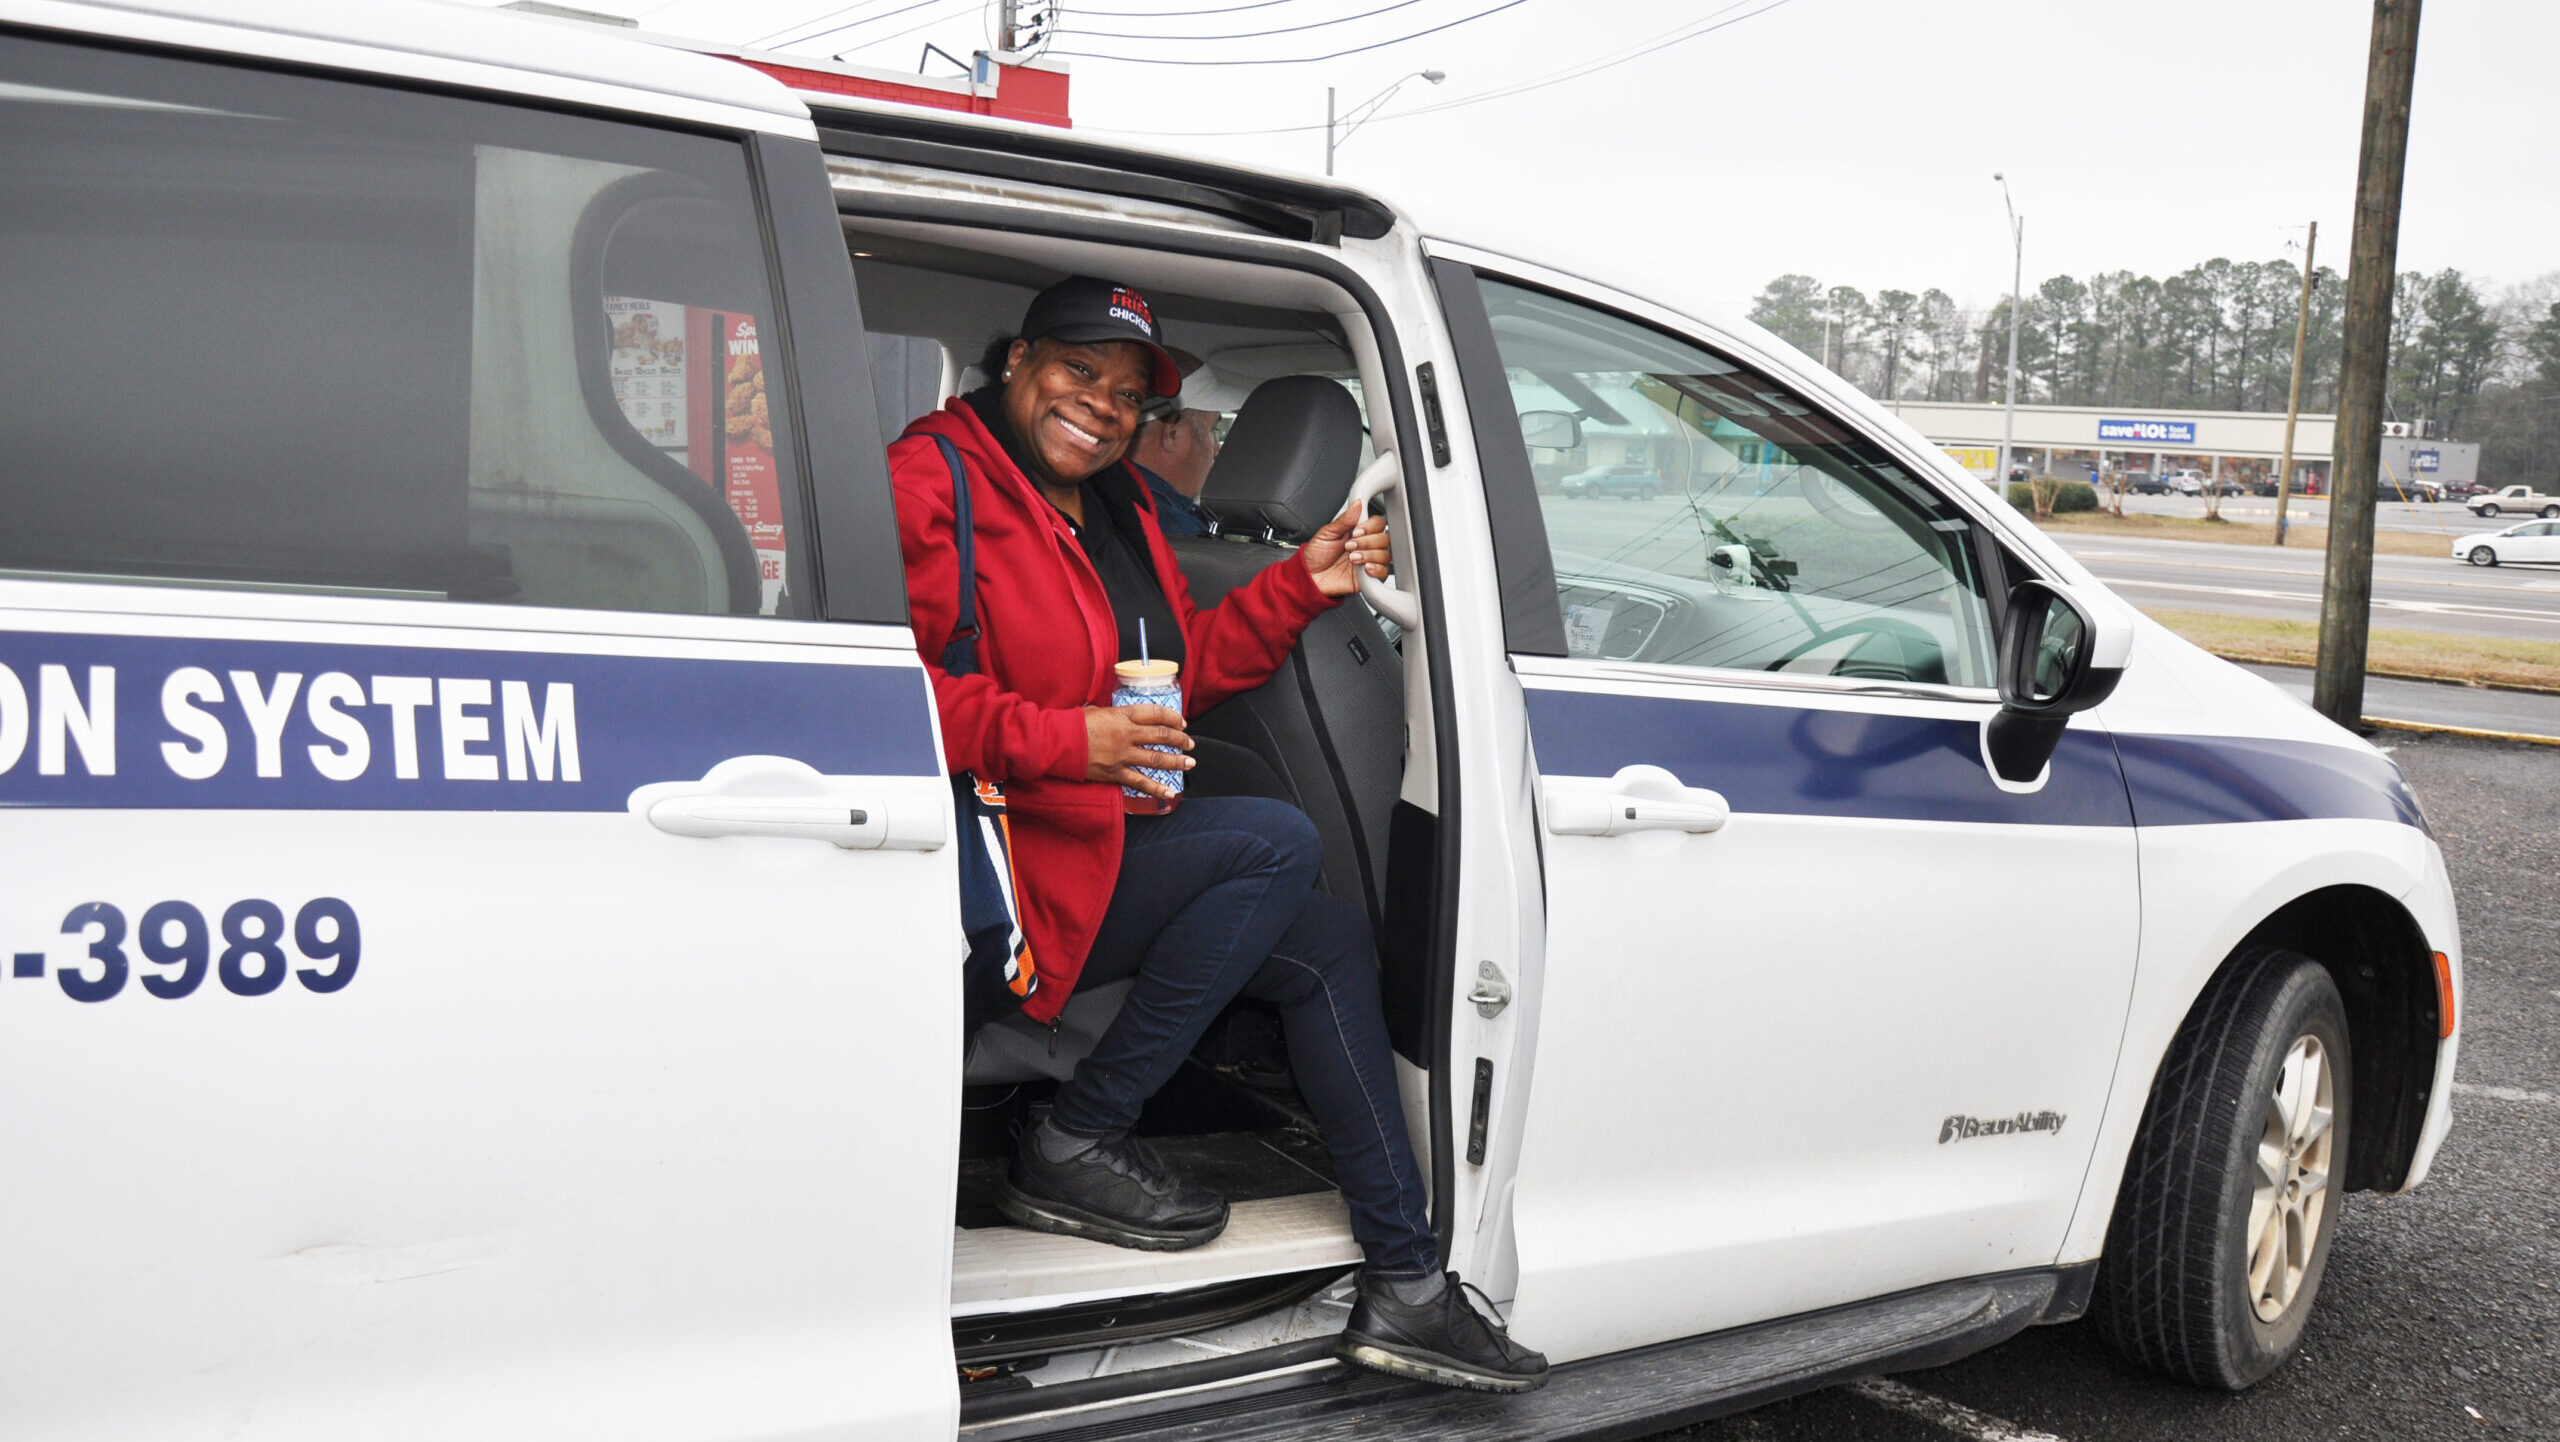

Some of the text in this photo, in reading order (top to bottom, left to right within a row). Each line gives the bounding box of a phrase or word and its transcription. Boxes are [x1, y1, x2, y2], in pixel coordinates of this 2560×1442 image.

[1109, 307, 1152, 337] CHICKEN
[1112, 293, 1153, 324] FRIED
[754, 521, 783, 536] Saucy
[160, 665, 583, 783] SYSTEM
[0, 896, 362, 1003] -3989
[1962, 1110, 2067, 1139] BraunAbility
